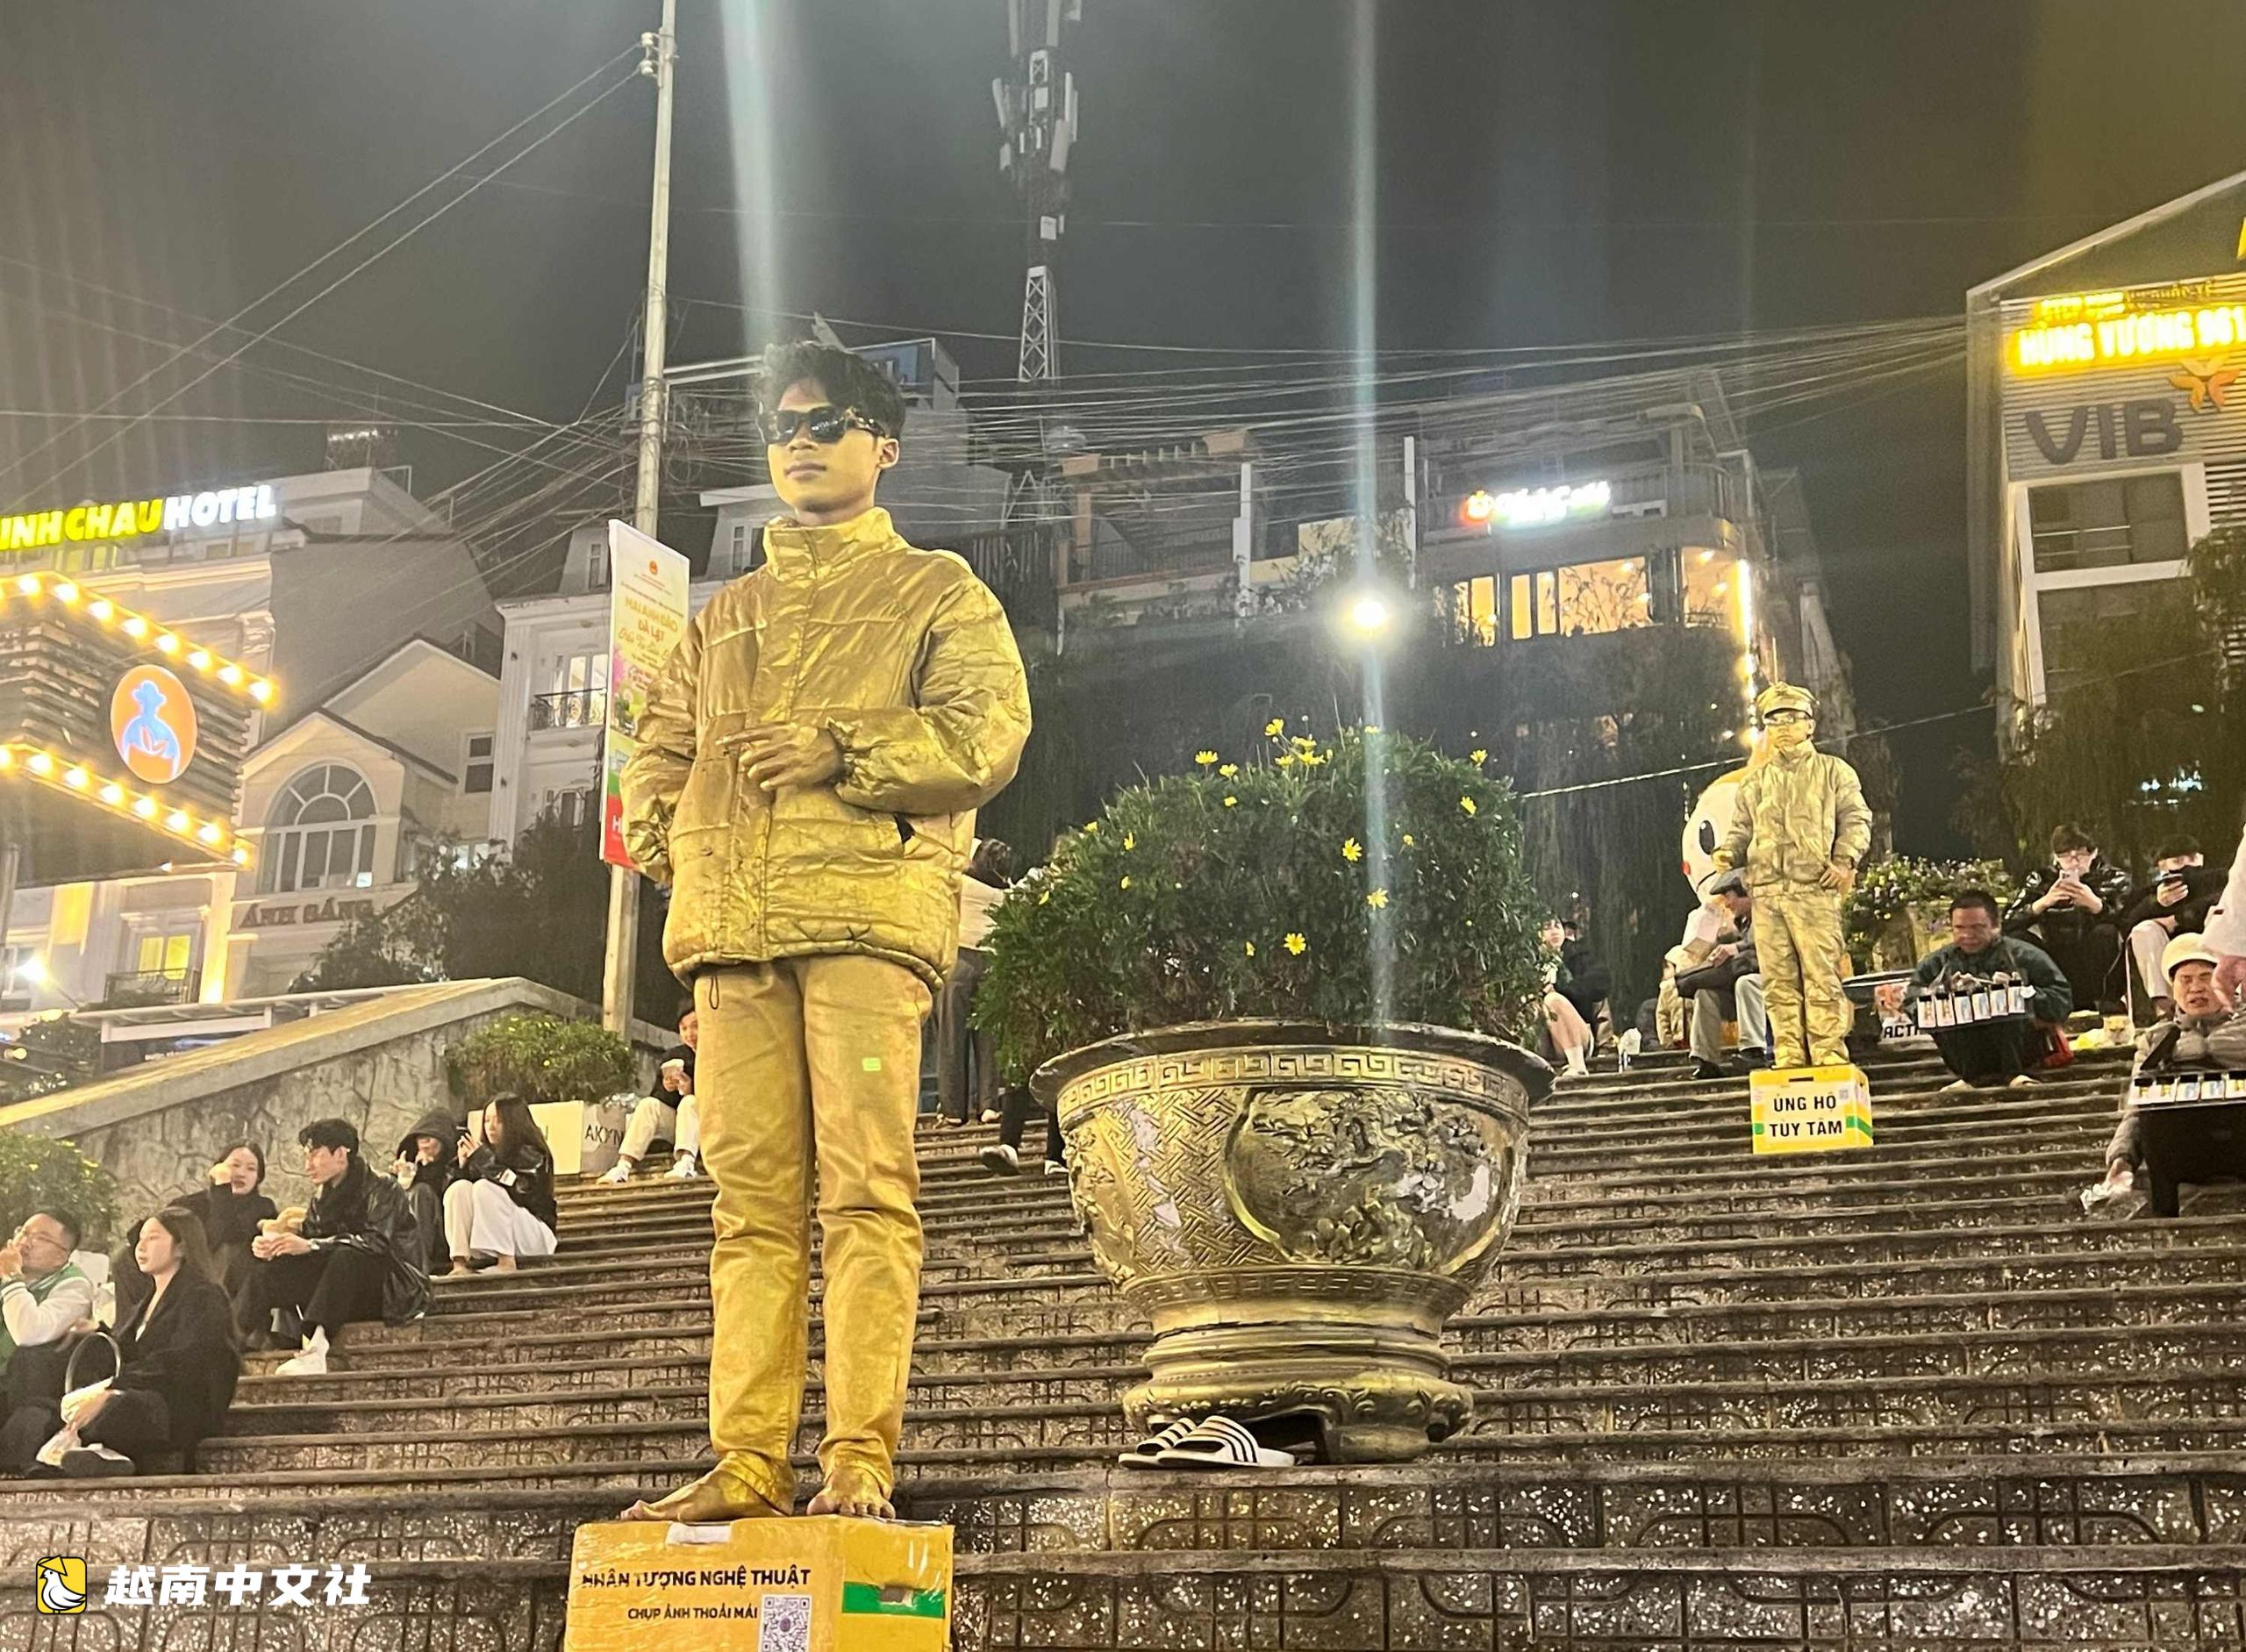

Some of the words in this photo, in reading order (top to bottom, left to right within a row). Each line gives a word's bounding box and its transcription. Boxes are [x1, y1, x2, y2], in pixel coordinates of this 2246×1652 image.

[2025, 397, 2184, 464] VIB
[164, 485, 276, 530] HOTEL
[700, 1564, 747, 1589] NGHỆ
[750, 1564, 812, 1589] THUẬT
[628, 1608, 661, 1620] CHỤP
